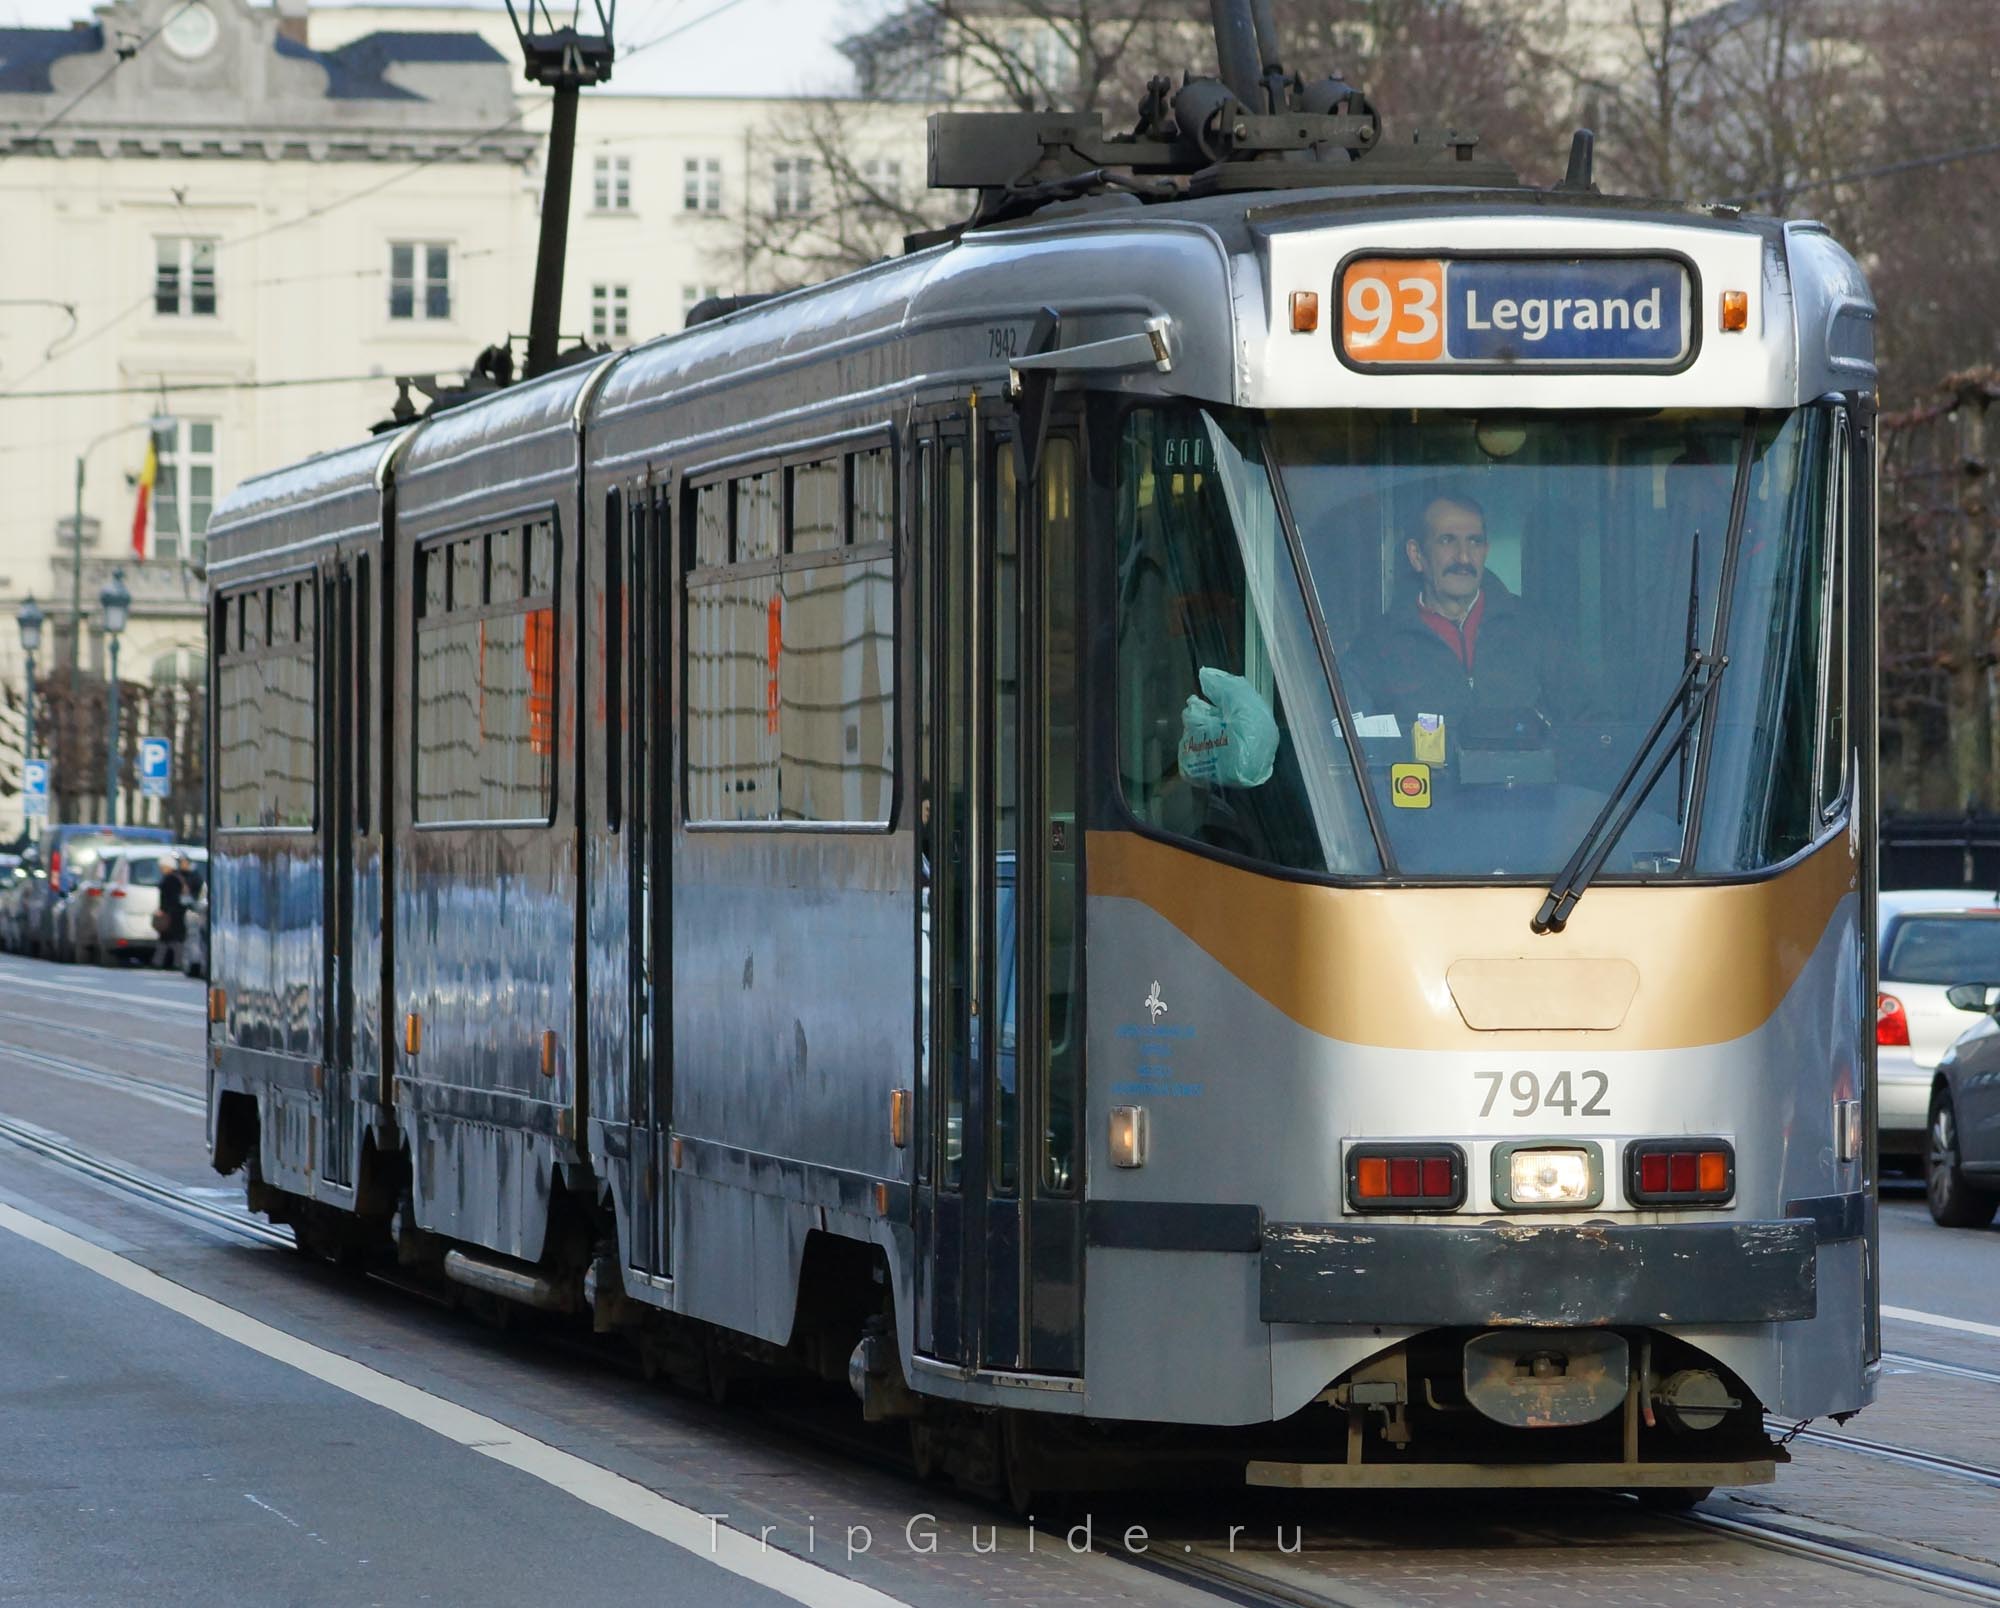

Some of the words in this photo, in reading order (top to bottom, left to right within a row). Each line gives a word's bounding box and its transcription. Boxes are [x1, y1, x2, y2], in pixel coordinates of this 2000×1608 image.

[1346, 277, 1439, 346] 93
[1465, 287, 1661, 341] Legrand
[988, 327, 1017, 359] 7942
[143, 743, 166, 775] P
[24, 765, 44, 794] P
[1473, 1070, 1611, 1118] 7942
